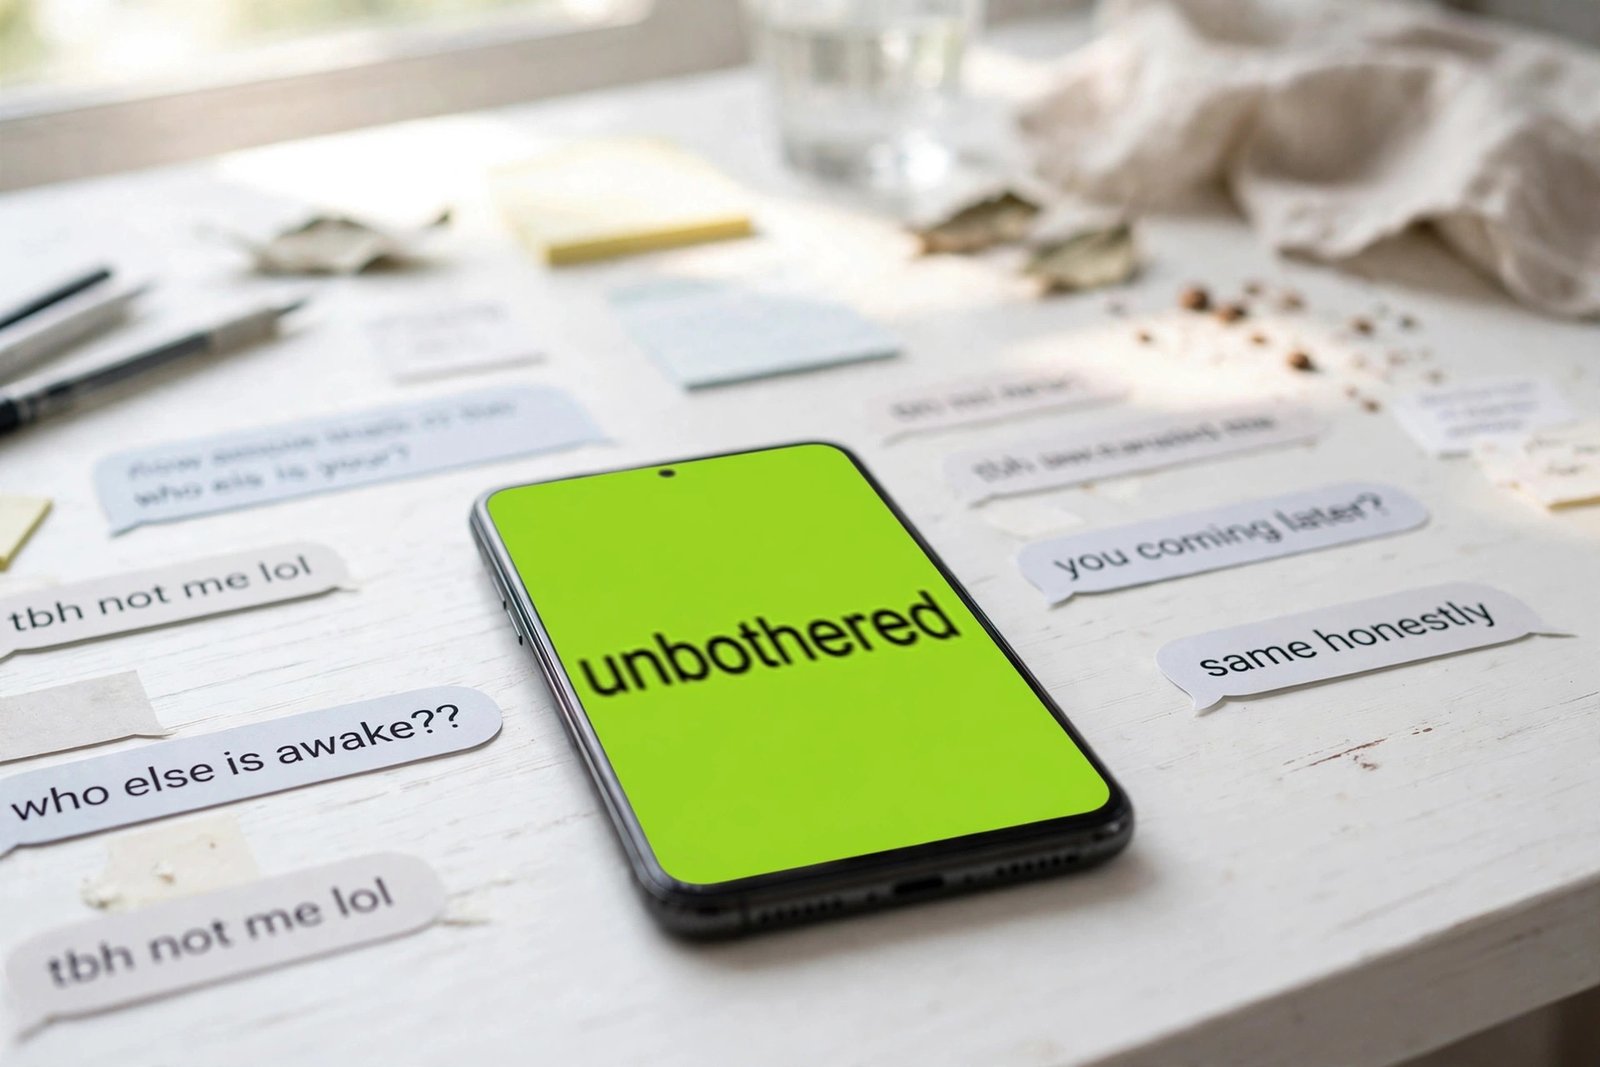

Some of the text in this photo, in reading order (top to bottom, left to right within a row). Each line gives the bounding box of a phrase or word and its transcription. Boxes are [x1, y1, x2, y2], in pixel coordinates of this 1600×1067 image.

[1053, 492, 1389, 582] you coming later?
[8, 554, 313, 633] tbh not me lol
[1199, 600, 1497, 678] same honestly
[577, 589, 961, 698] unbothered
[9, 703, 461, 822] who else is awake??
[46, 875, 395, 988] tbh not me lol
